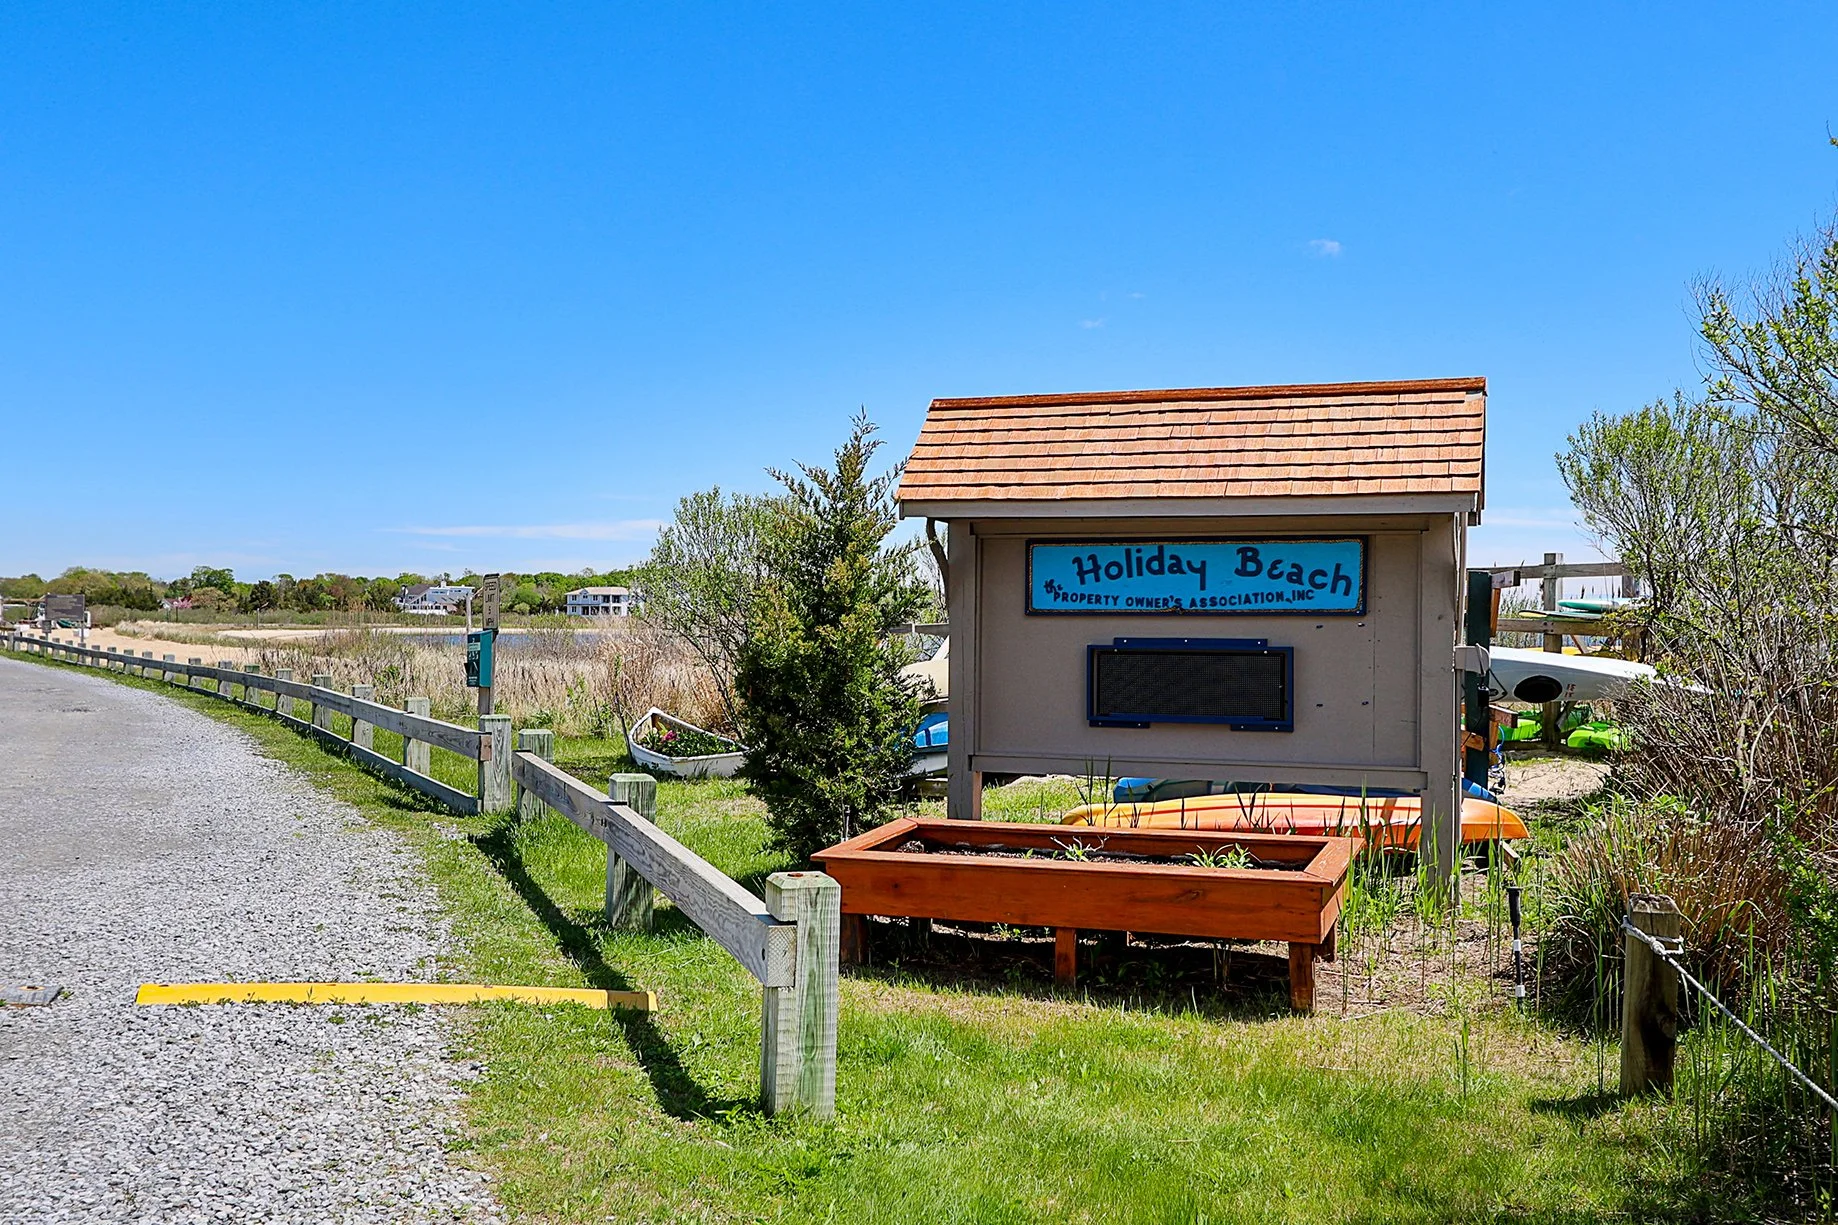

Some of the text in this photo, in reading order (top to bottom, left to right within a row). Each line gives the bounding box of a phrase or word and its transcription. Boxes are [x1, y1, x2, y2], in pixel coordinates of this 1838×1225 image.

[1072, 545, 1353, 597] Holiday Beach
[1044, 578, 1063, 594] the
[1053, 592, 1119, 606] PROPERTY
[1126, 595, 1183, 609] OWNER'S
